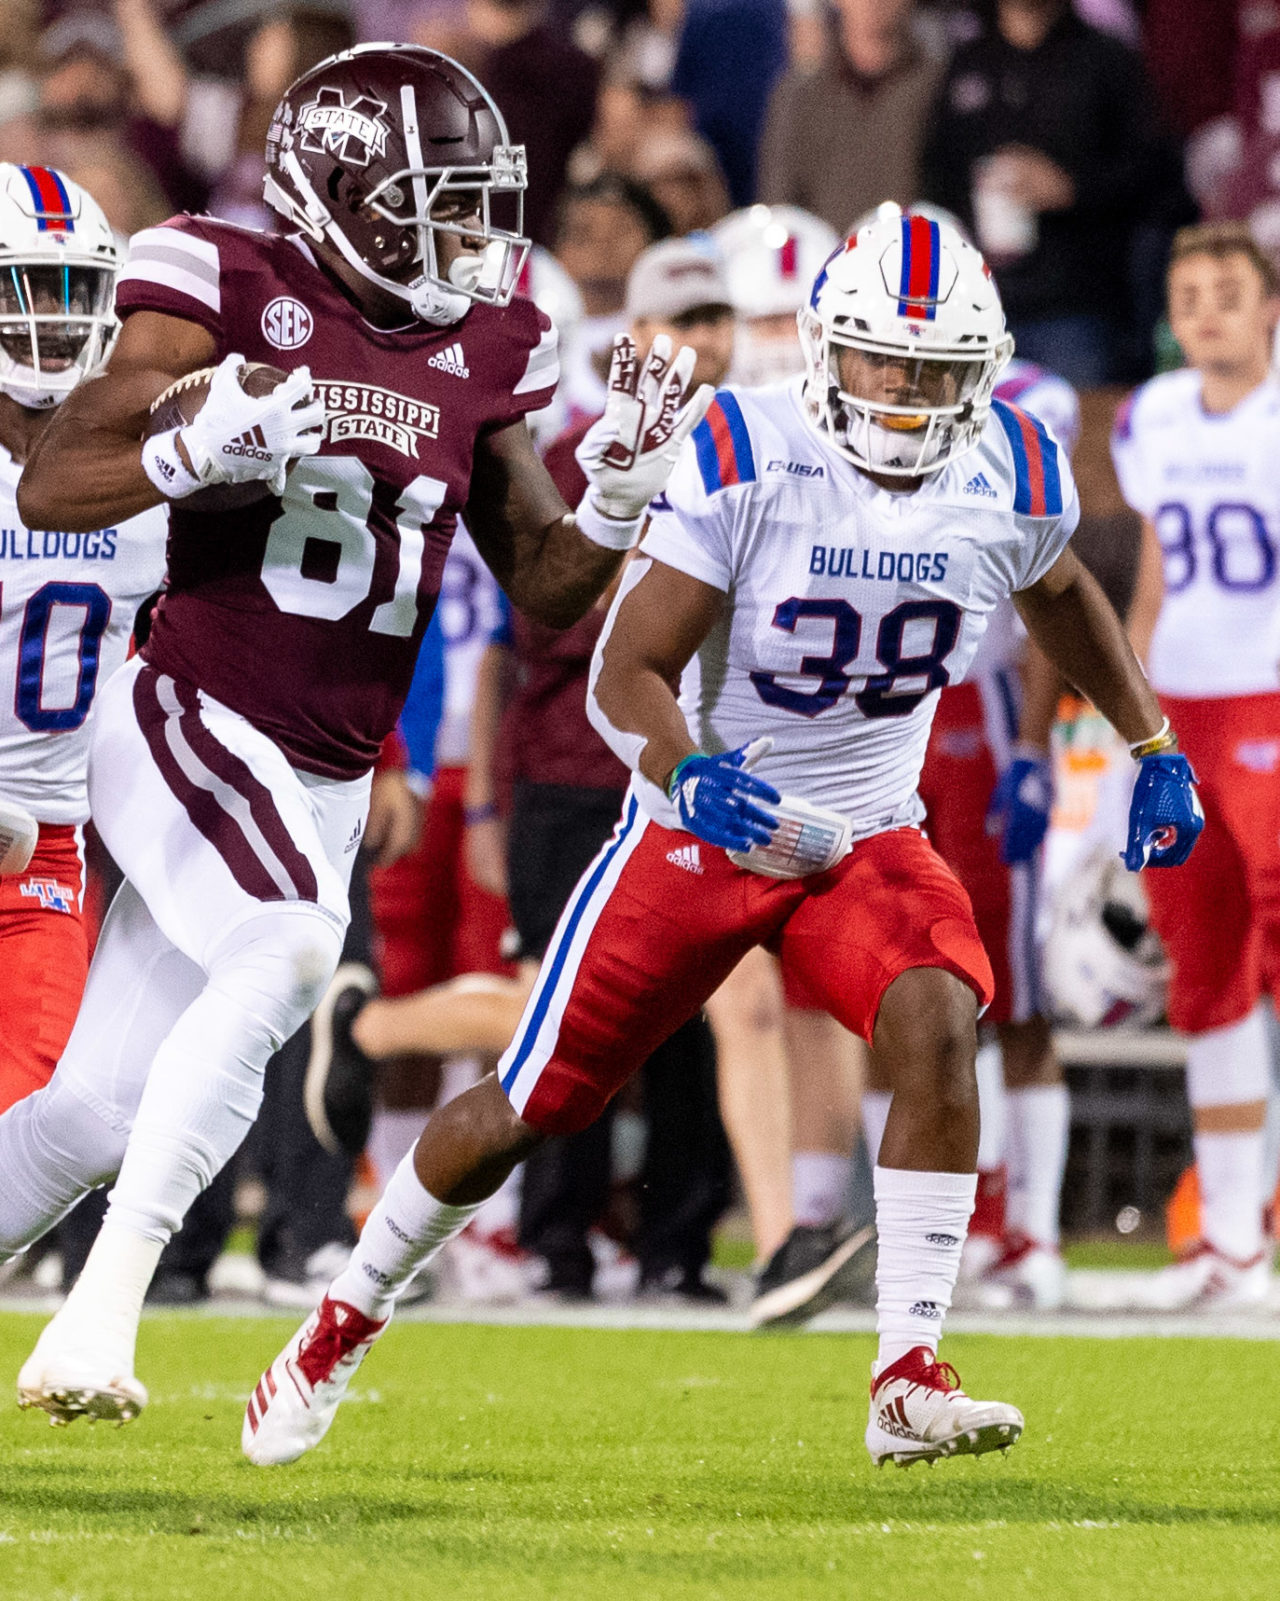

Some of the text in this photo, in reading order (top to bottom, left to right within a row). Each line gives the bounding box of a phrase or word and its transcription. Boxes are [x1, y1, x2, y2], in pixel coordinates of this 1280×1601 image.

[311, 110, 371, 141] STATE
[265, 301, 309, 346] SEC
[427, 356, 470, 379] adidas
[337, 419, 405, 450] STATE
[222, 442, 273, 463] adidas
[260, 456, 448, 638] 81
[809, 545, 949, 584] BULLDOGS
[749, 596, 962, 720] 38
[665, 852, 704, 875] adidas
